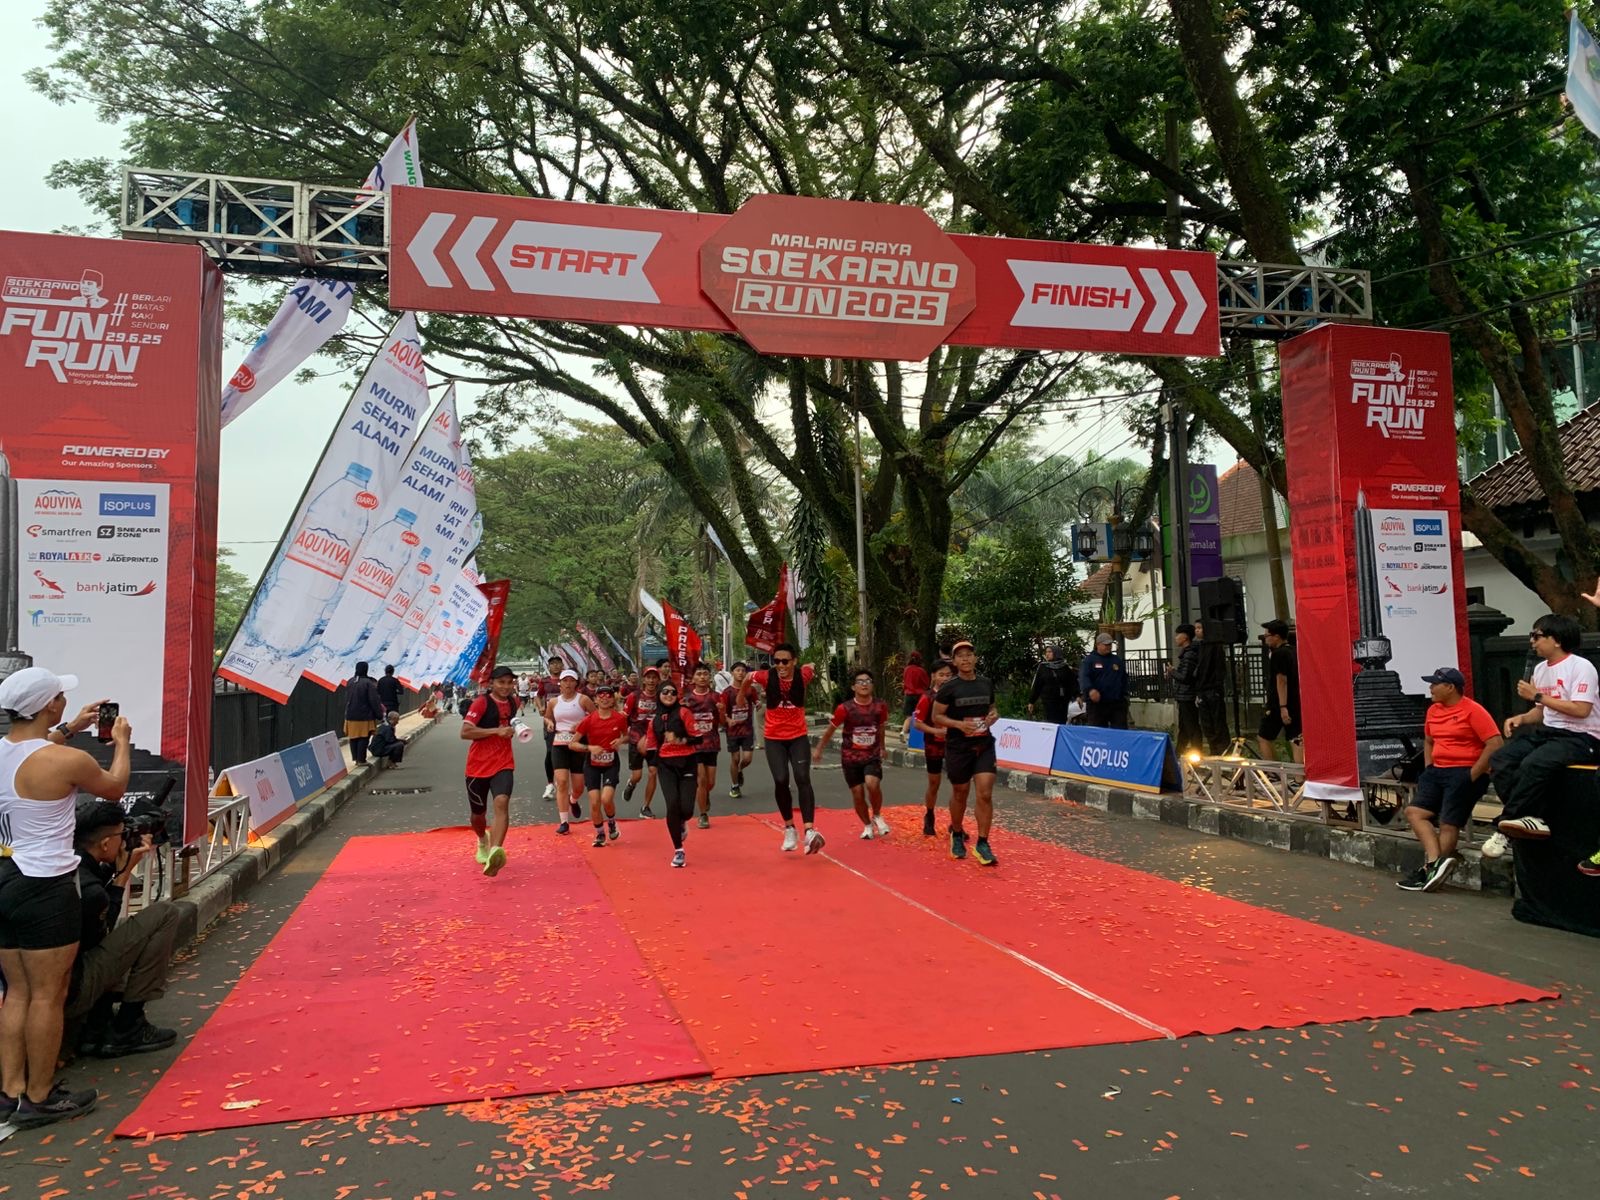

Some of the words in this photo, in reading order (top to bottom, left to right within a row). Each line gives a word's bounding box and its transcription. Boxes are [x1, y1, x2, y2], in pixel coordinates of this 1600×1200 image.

[770, 233, 857, 252] MALANG
[860, 240, 912, 256] RAYA
[509, 244, 638, 277] START
[720, 246, 959, 289] SOEKARNO
[7, 277, 80, 292] SOEKARNO
[9, 287, 38, 297] RUN
[1031, 282, 1132, 309] FINISH
[132, 293, 172, 304] BERLARI
[132, 303, 165, 312] DIATAS
[290, 285, 332, 325] AMI
[739, 283, 837, 316] RUN
[843, 291, 940, 321] 2025
[0, 307, 109, 341] FUN
[131, 312, 154, 320] KAKI
[131, 321, 169, 331] SENDIRI
[106, 332, 163, 345] 29.6.25
[25, 339, 141, 383] RUN
[370, 382, 417, 422] MURNI
[1351, 382, 1407, 406] FUN
[361, 401, 411, 439] SEHAT
[1366, 406, 1425, 438] RUN
[351, 419, 401, 457] ALAMI
[62, 444, 147, 459] POWERED
[147, 447, 170, 460] BY
[419, 446, 458, 475] MURN
[62, 459, 77, 468] Our
[78, 460, 115, 470] Amazing
[411, 460, 455, 489] SEHAT
[402, 475, 446, 504] ALAMI
[1391, 484, 1434, 493] POWERED
[1434, 485, 1447, 493] BY
[34, 495, 82, 510] AQUVIVA
[104, 501, 151, 512] ISOPLUS
[356, 494, 377, 508] BARU
[41, 528, 92, 537] smartfren
[1415, 524, 1441, 532] ISOPLUS
[295, 530, 351, 567] AQUVIVA
[1190, 540, 1217, 550] amalat
[356, 560, 395, 588] QUVIVA
[1080, 745, 1130, 769] ISOPLUS
